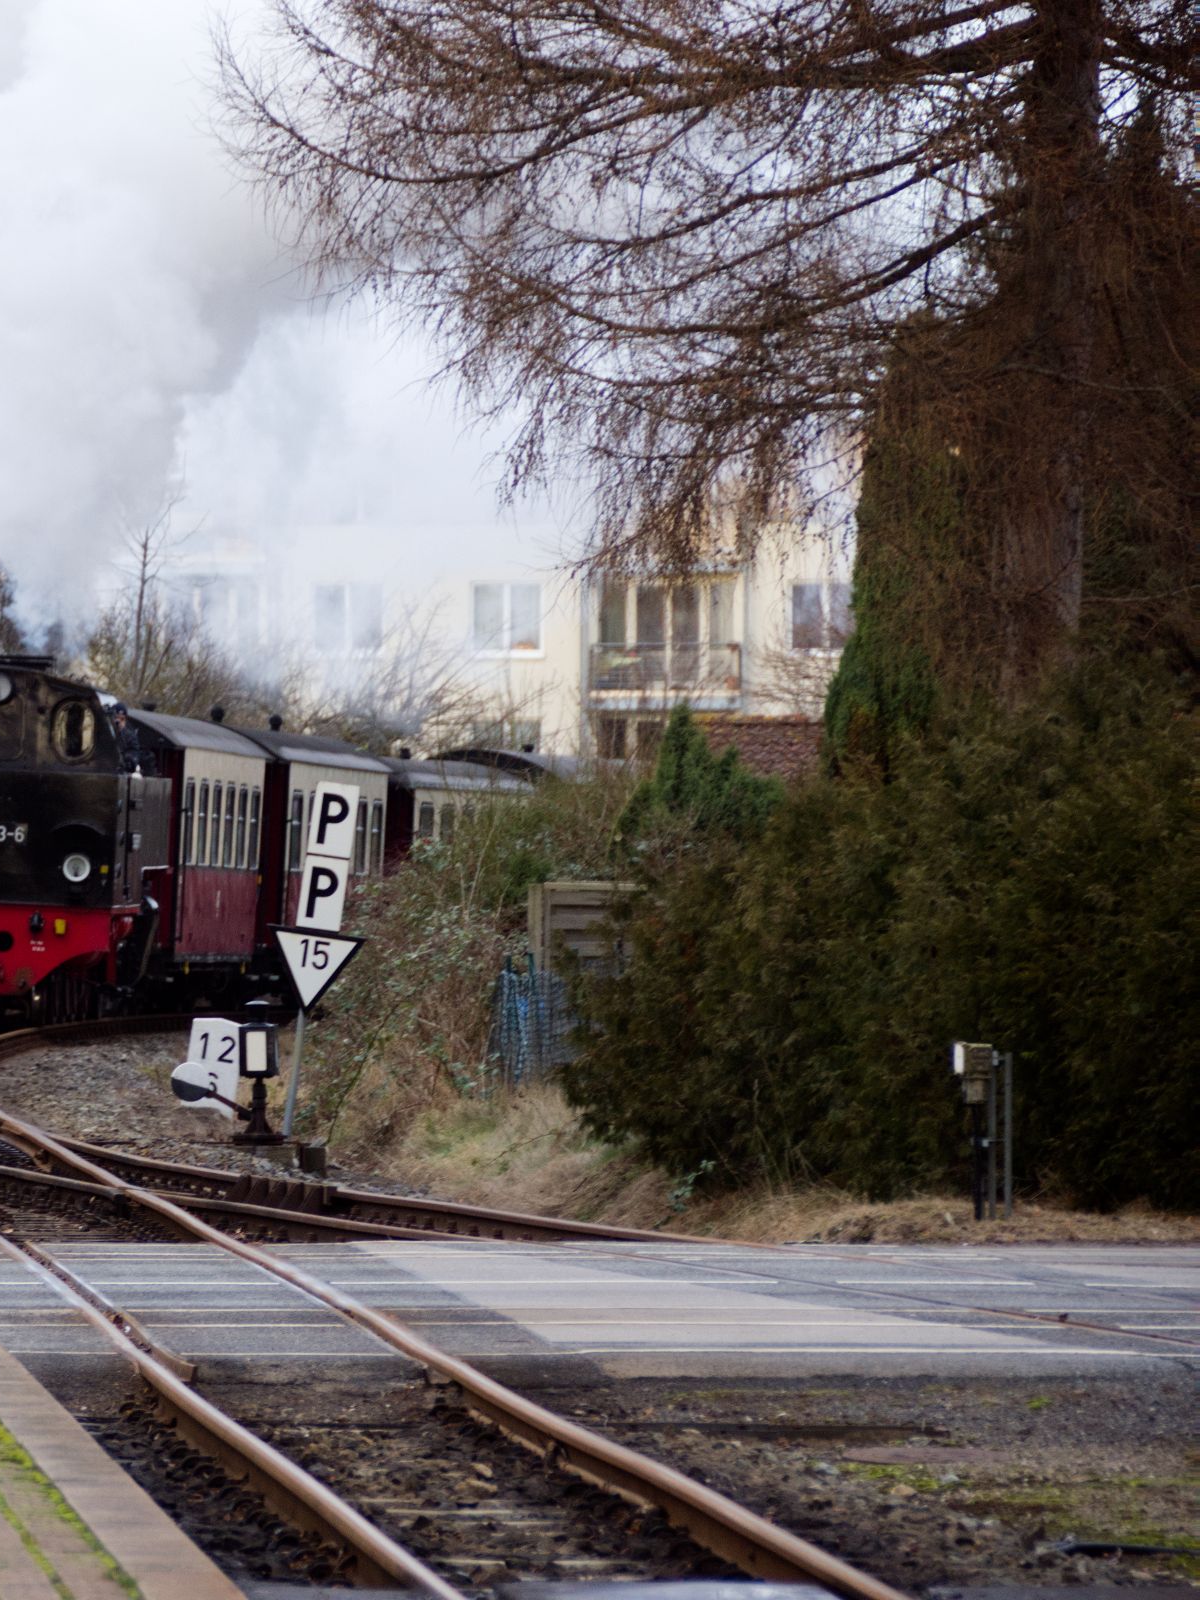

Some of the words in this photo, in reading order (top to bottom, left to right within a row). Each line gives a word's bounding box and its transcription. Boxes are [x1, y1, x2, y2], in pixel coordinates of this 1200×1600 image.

[316, 792, 350, 845] P
[305, 865, 339, 918] P
[300, 938, 331, 971] 15
